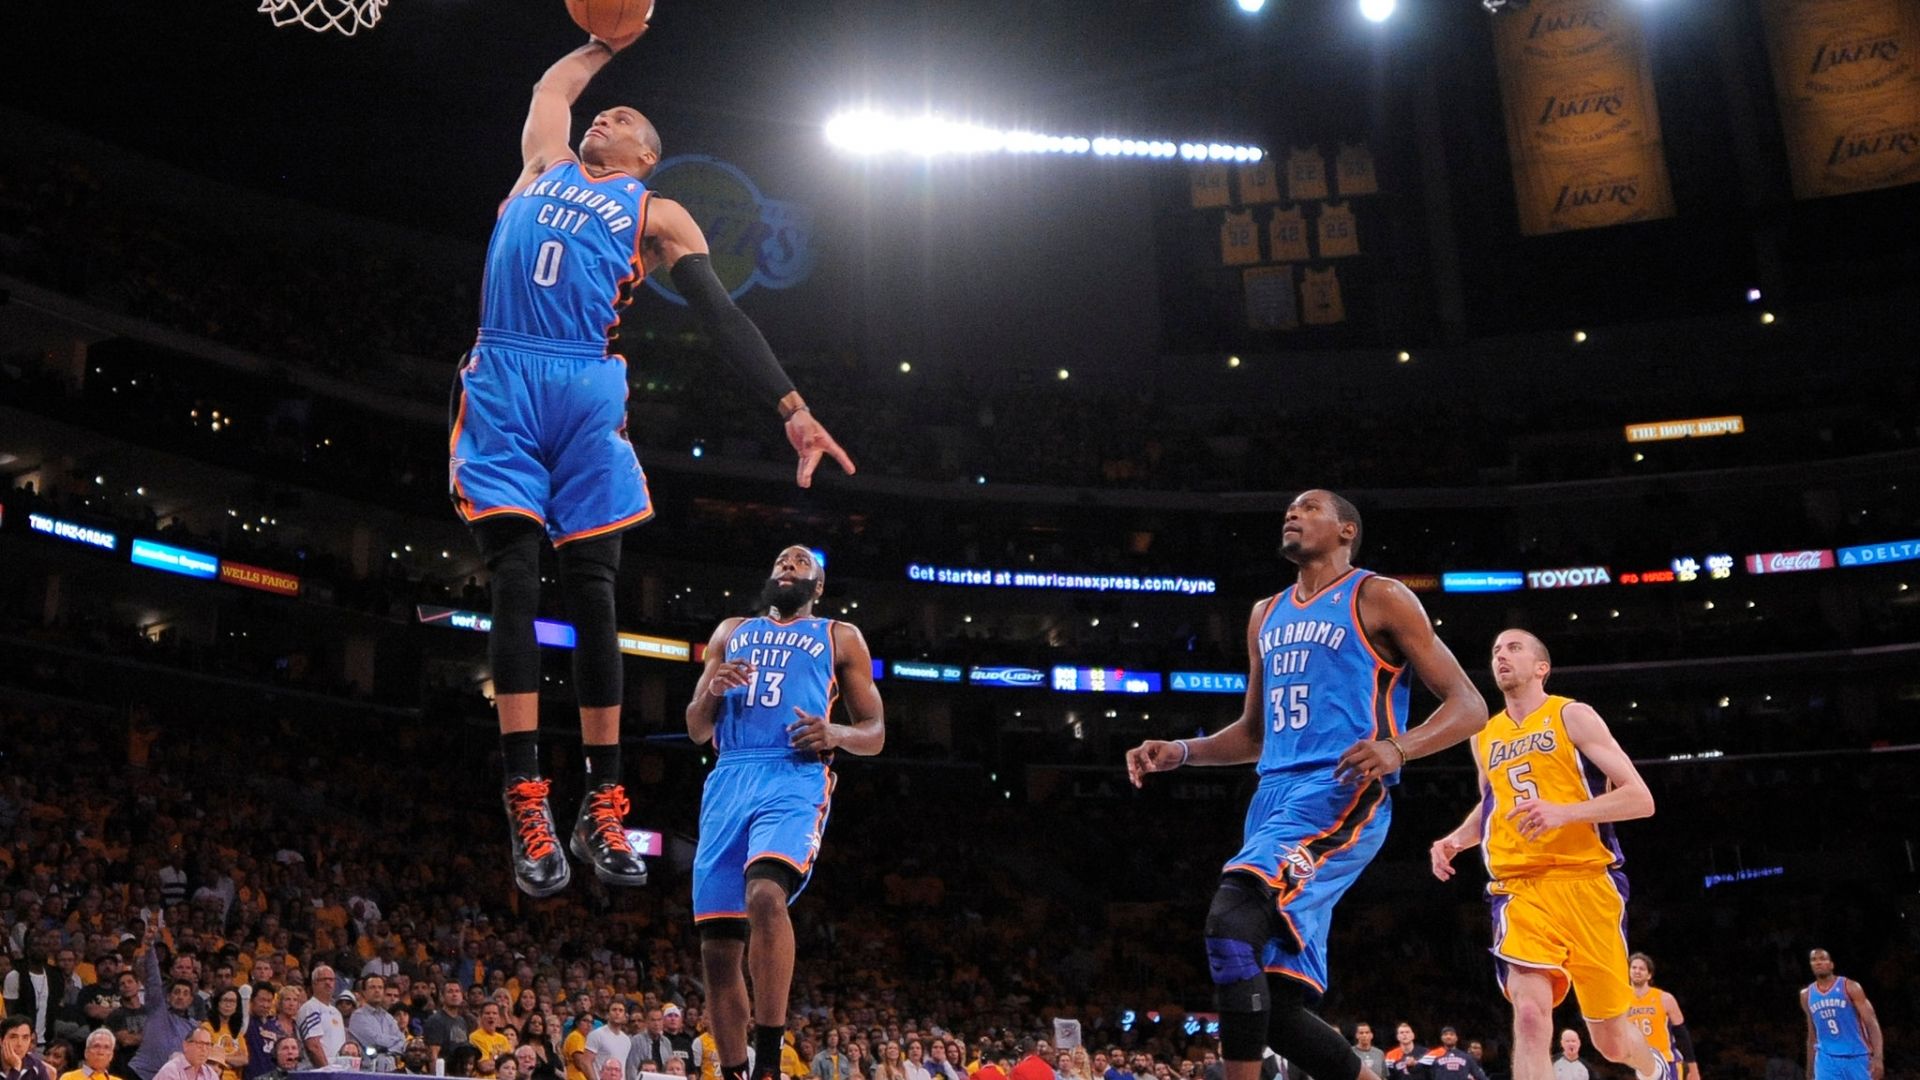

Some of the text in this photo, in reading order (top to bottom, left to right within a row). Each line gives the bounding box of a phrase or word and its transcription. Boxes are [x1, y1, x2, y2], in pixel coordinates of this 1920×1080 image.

[1811, 40, 1900, 74] LAKERS
[1540, 93, 1623, 124] LAKERS
[523, 180, 633, 233] OKLAHOMA
[1553, 182, 1638, 213] LAKERS
[537, 203, 590, 235] CITY
[533, 241, 564, 287] 0
[1631, 419, 1740, 440] THE HOME DEPOT
[222, 565, 299, 591] WELLS FARGO
[910, 565, 1216, 593] Get started at americanexpress.com/sync
[1528, 567, 1612, 589] TOYOTA
[729, 630, 826, 658] OKLAHOMA
[1259, 620, 1346, 659] OKLAHOMA
[751, 648, 792, 668] CITY
[893, 664, 939, 679] Panasonic
[1273, 649, 1310, 676] CITY
[746, 671, 786, 708] 13
[1190, 675, 1245, 690] DELTA
[1270, 684, 1310, 733] 35
[1488, 730, 1556, 770] LAKERS
[1507, 762, 1540, 806] 5
[1827, 1019, 1840, 1035] 9
